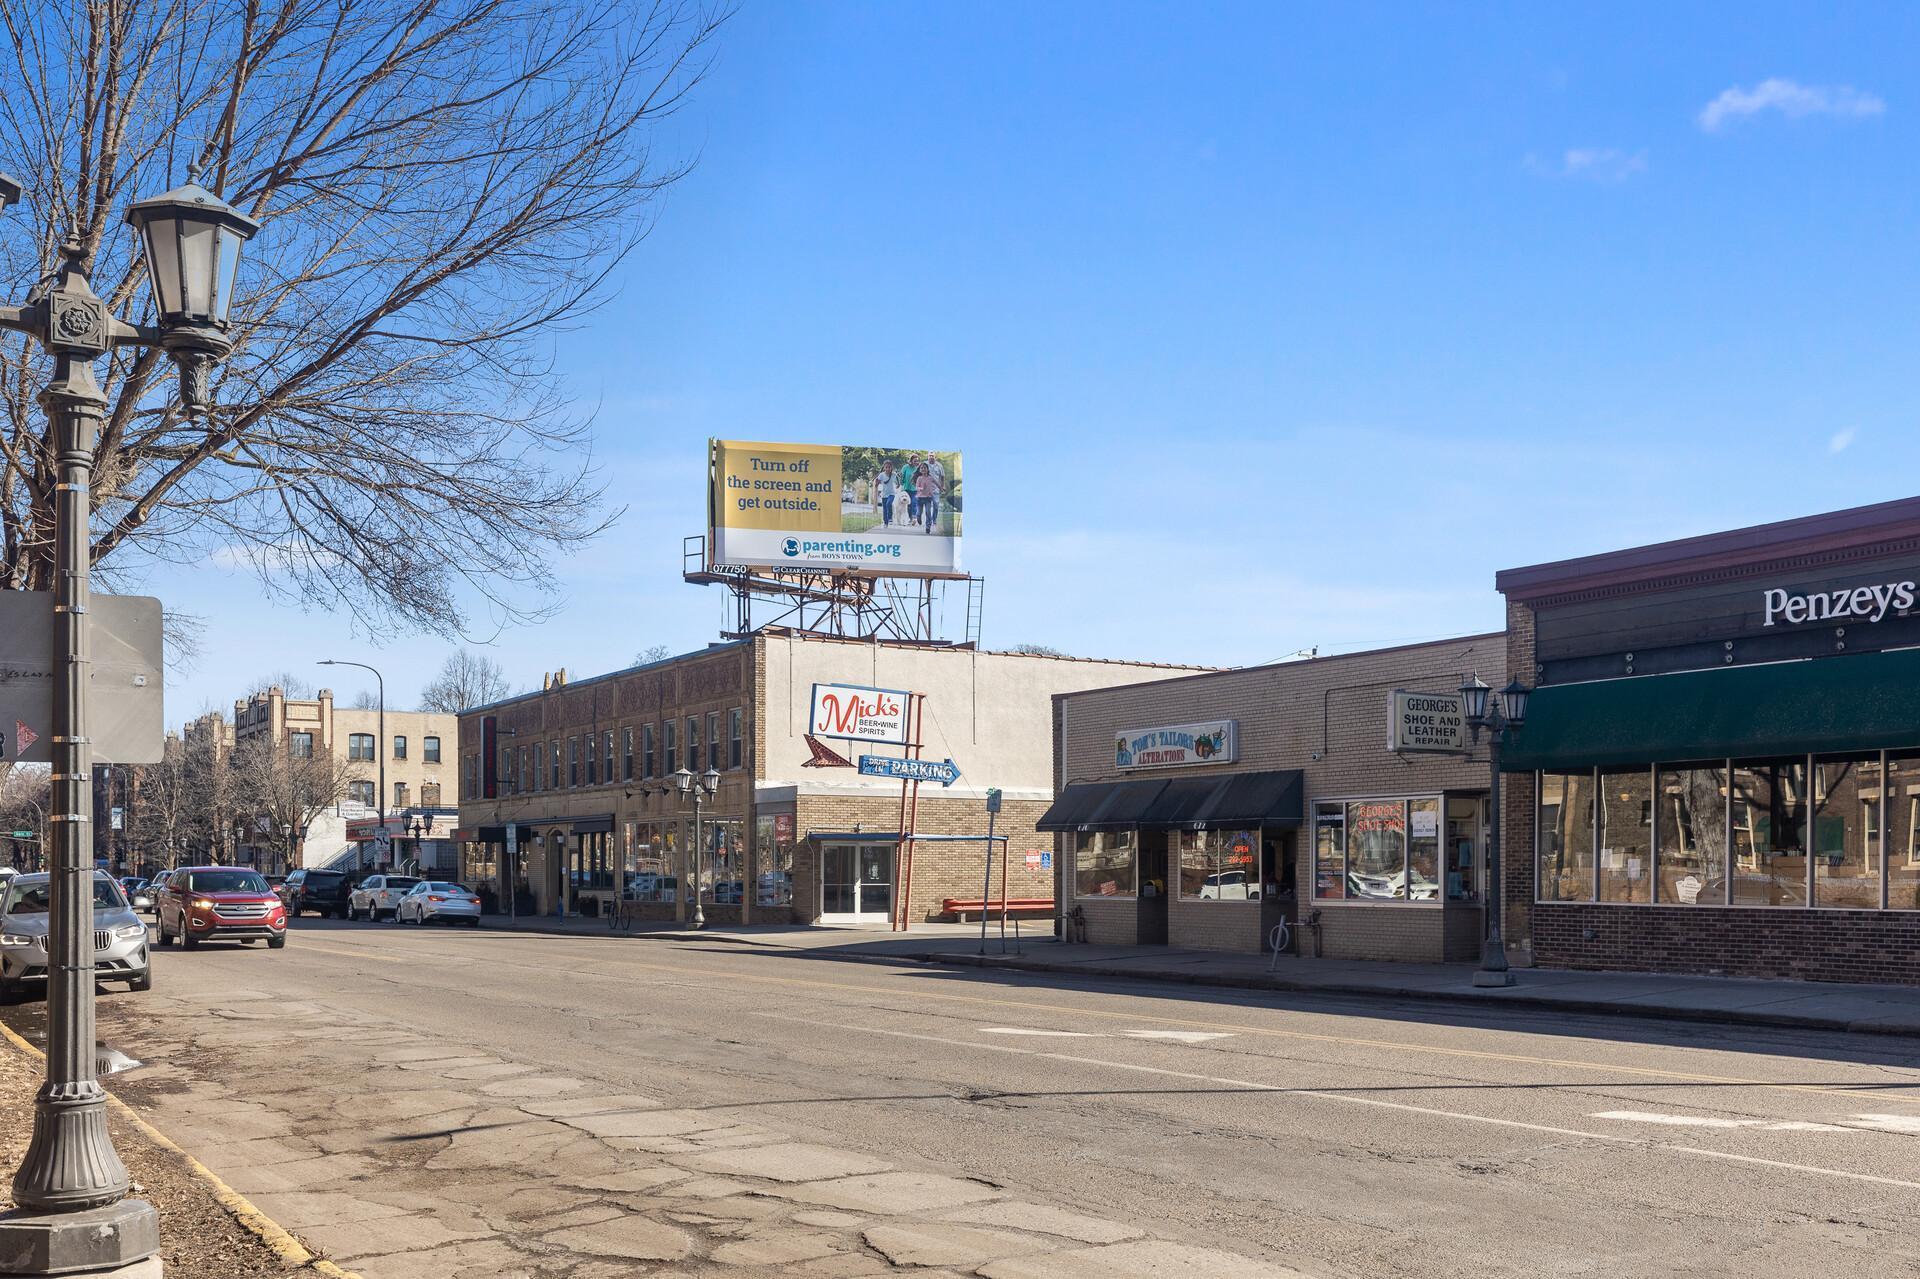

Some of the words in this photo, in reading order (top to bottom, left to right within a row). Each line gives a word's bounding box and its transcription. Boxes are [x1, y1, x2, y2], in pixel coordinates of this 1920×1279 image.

[750, 458, 785, 472] Turn
[789, 459, 810, 473] off
[727, 475, 750, 488] the
[754, 478, 801, 491] screen
[805, 480, 832, 492] and
[738, 496, 760, 510] get
[764, 497, 821, 511] outside.
[803, 539, 901, 557] parenting.org
[712, 564, 747, 574] 077750
[1763, 581, 1915, 626] Penzeys
[1407, 698, 1458, 713] GEORGE'S
[818, 693, 899, 734] Mick's
[1404, 714, 1435, 726] SHOE
[1439, 716, 1461, 727] AND
[858, 727, 886, 736] SPIRITS
[1408, 726, 1457, 737] LEATHER
[1158, 731, 1194, 750] TAILORS
[1415, 737, 1450, 745] REPAIR
[1138, 749, 1185, 764] ALTERATIONS
[891, 760, 952, 779] PARKING
